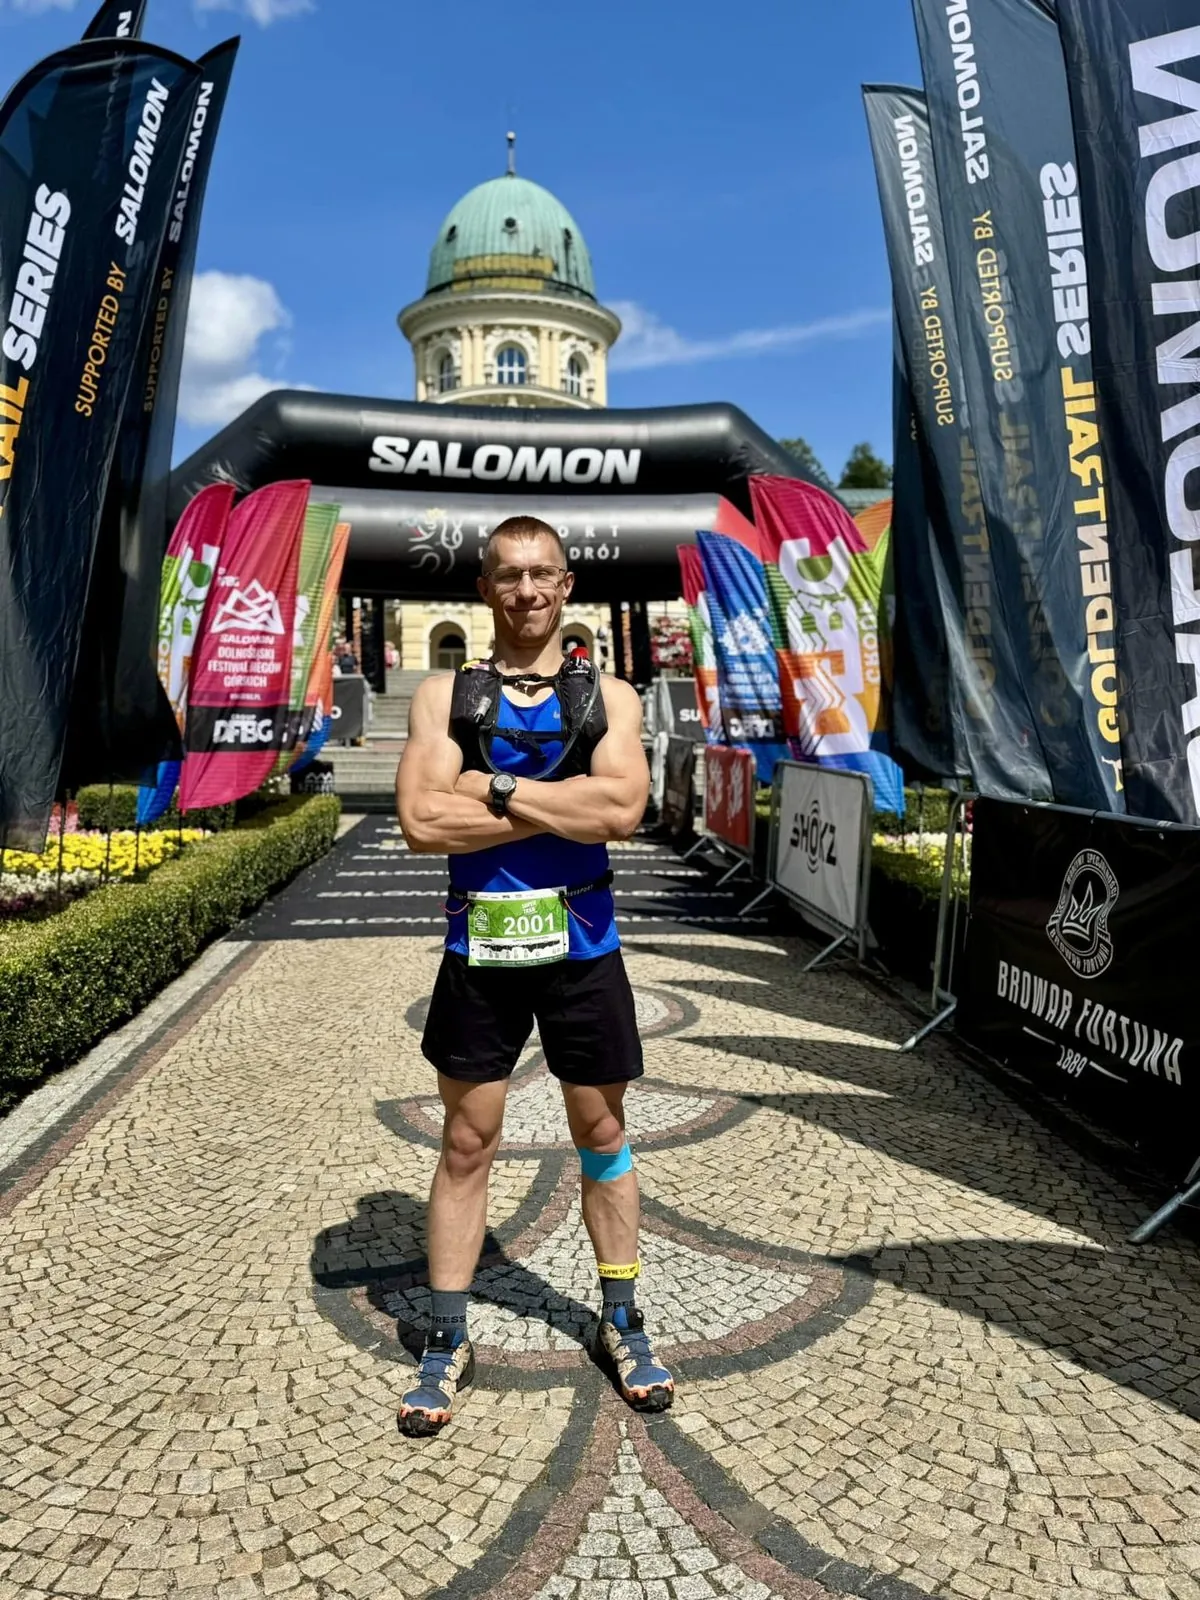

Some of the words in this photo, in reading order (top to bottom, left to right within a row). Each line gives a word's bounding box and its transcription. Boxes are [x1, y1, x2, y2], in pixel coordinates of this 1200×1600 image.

[115, 77, 170, 245] SALOMON
[143, 299, 173, 412] SUPPORTED
[160, 267, 174, 291] BY
[168, 82, 214, 244] SALOMON
[2, 183, 72, 371] SERIES
[107, 261, 127, 293] BY
[75, 298, 120, 417] SUPPORTED
[368, 435, 641, 484] SALOMON
[478, 524, 620, 538] KORT
[213, 719, 273, 743] DFBG
[503, 912, 554, 936] 2001
[997, 960, 1072, 1031] BROWAR
[1075, 997, 1184, 1086] FORTUNA
[1056, 1044, 1088, 1078] 1889
